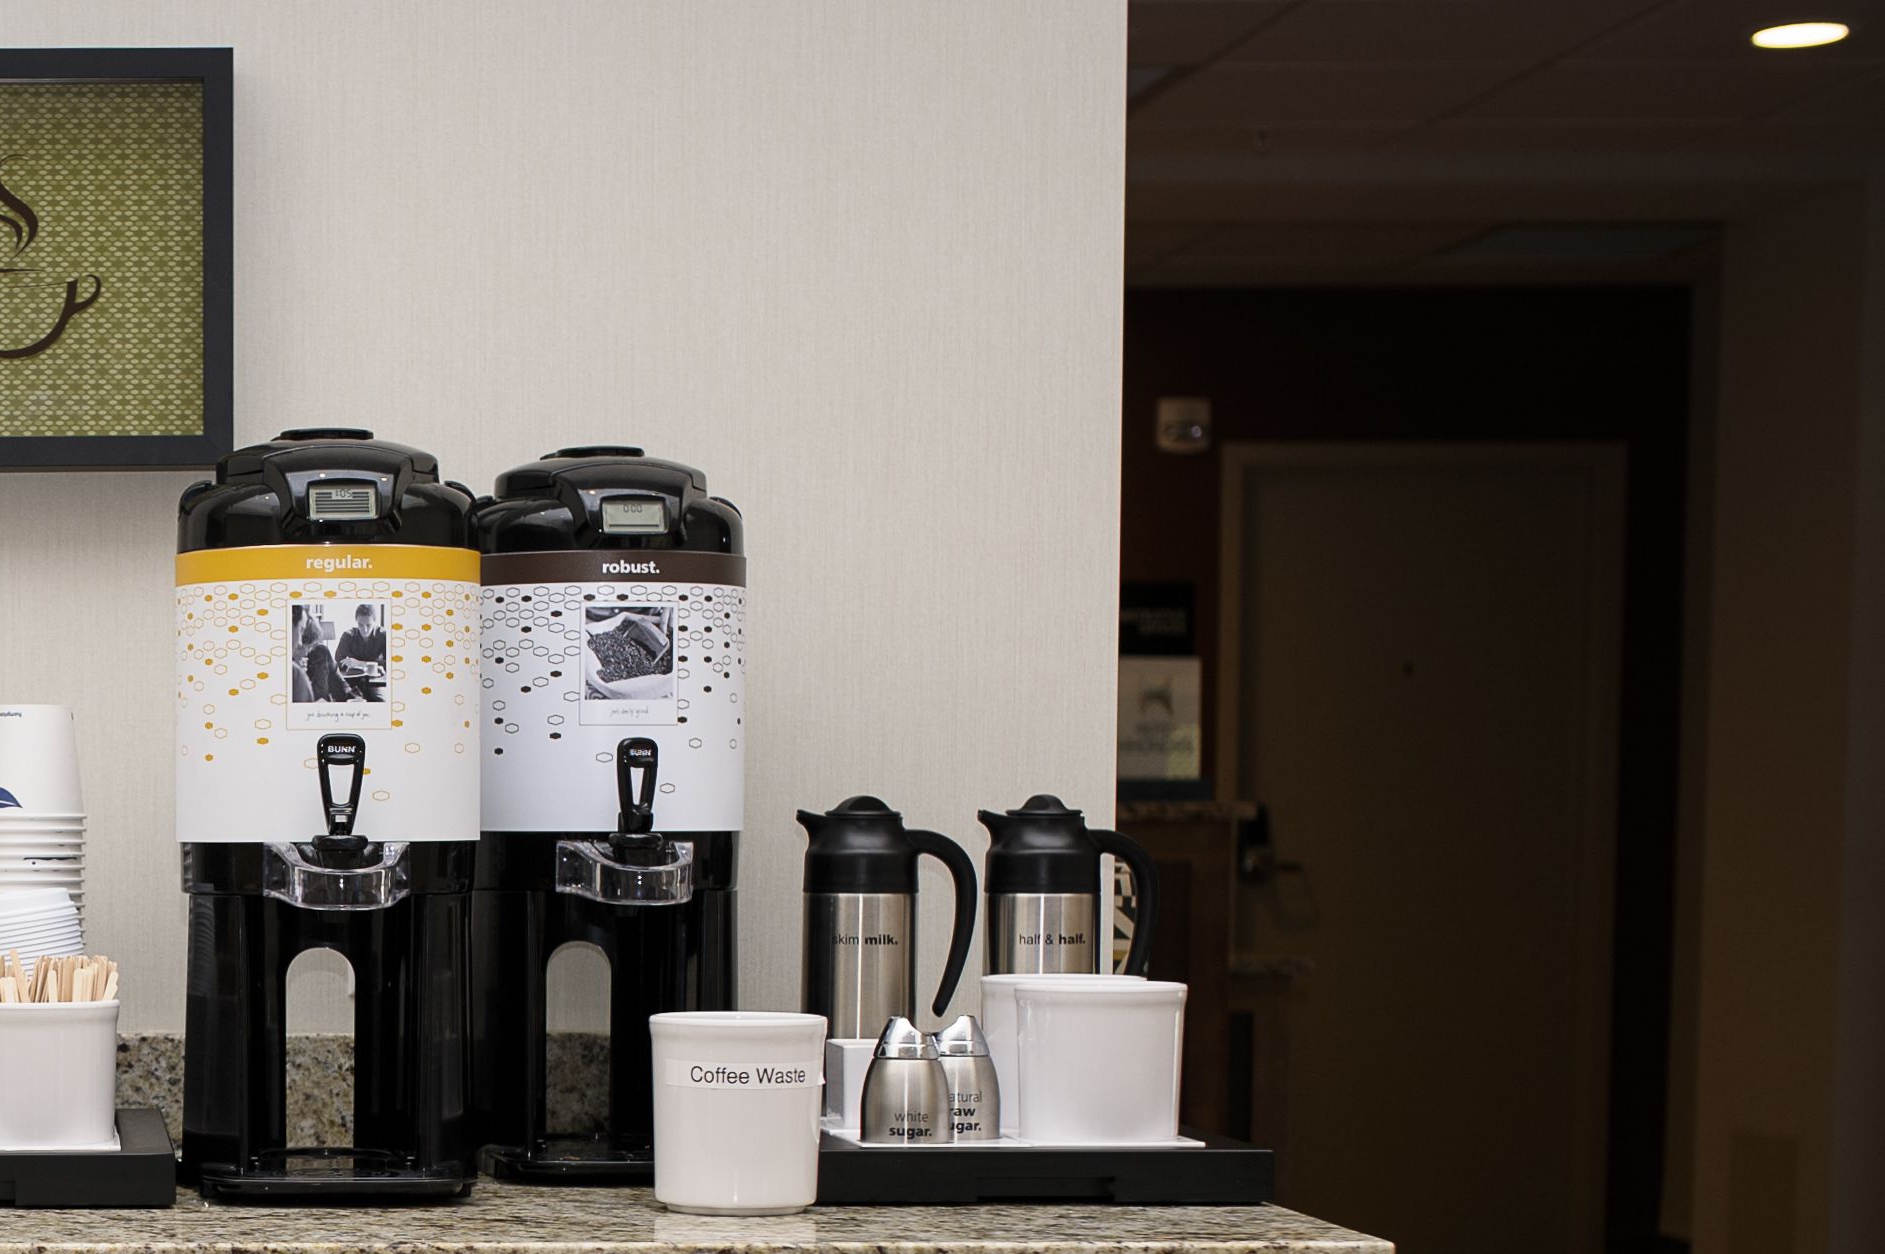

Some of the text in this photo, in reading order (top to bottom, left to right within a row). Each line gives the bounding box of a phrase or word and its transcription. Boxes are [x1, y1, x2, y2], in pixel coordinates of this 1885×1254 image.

[306, 554, 373, 573] regular.
[602, 559, 660, 574] robust.
[327, 745, 356, 753] BUNN
[831, 933, 898, 945] skim milk.
[1019, 933, 1086, 945] half & half.
[690, 1065, 806, 1084] Coffee Waste
[949, 1090, 982, 1102] atural
[894, 1111, 929, 1122] white
[889, 1126, 932, 1139] sugar.
